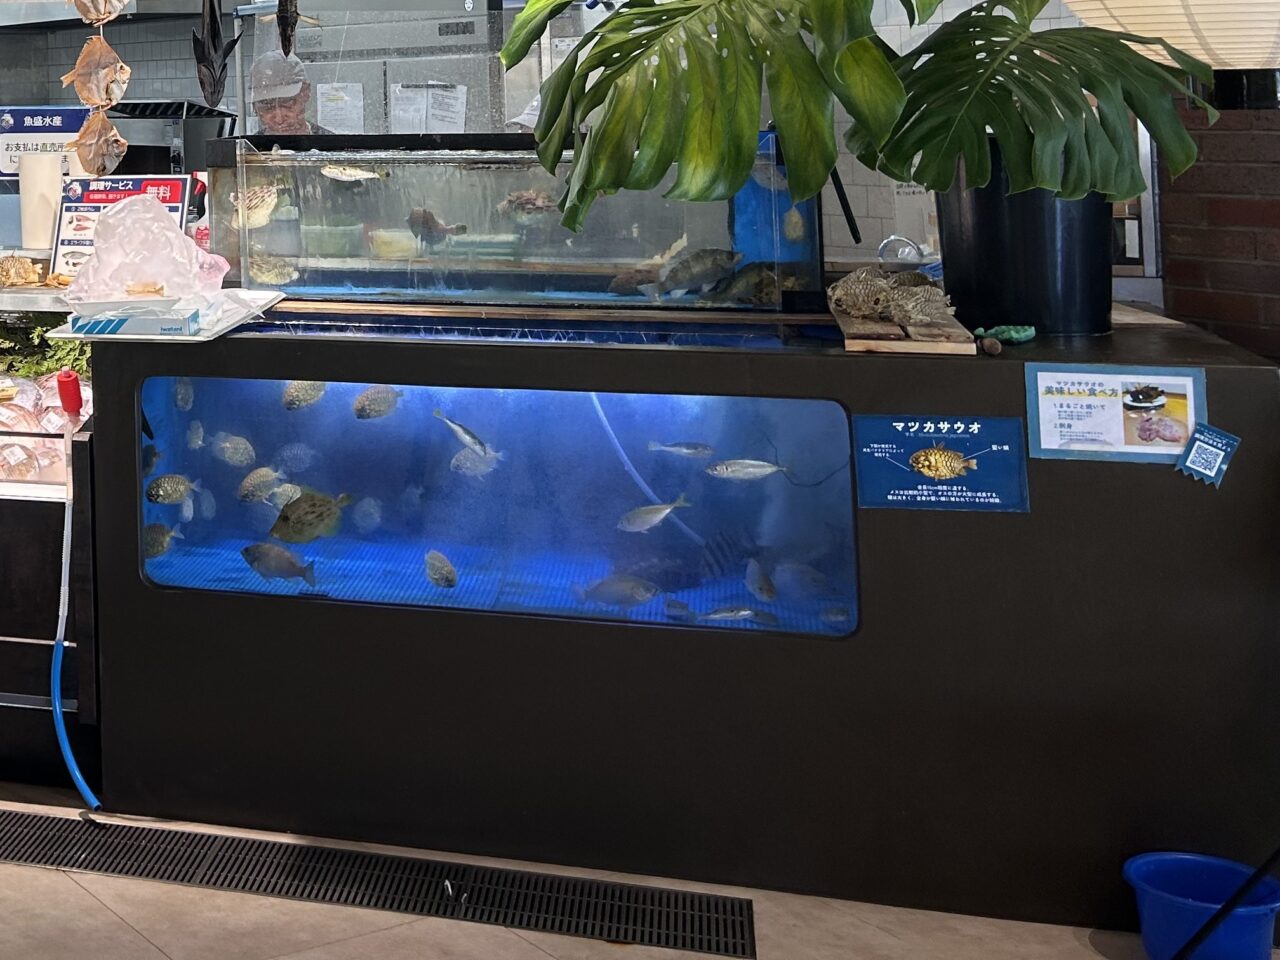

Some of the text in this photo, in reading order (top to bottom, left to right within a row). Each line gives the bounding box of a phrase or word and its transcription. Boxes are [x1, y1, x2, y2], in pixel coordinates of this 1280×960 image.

[23, 116, 63, 127] 魚盛水産
[145, 185, 171, 200] 無料
[1044, 385, 1119, 398] 美味しい食べ方
[892, 421, 982, 435] マツカサウオ
